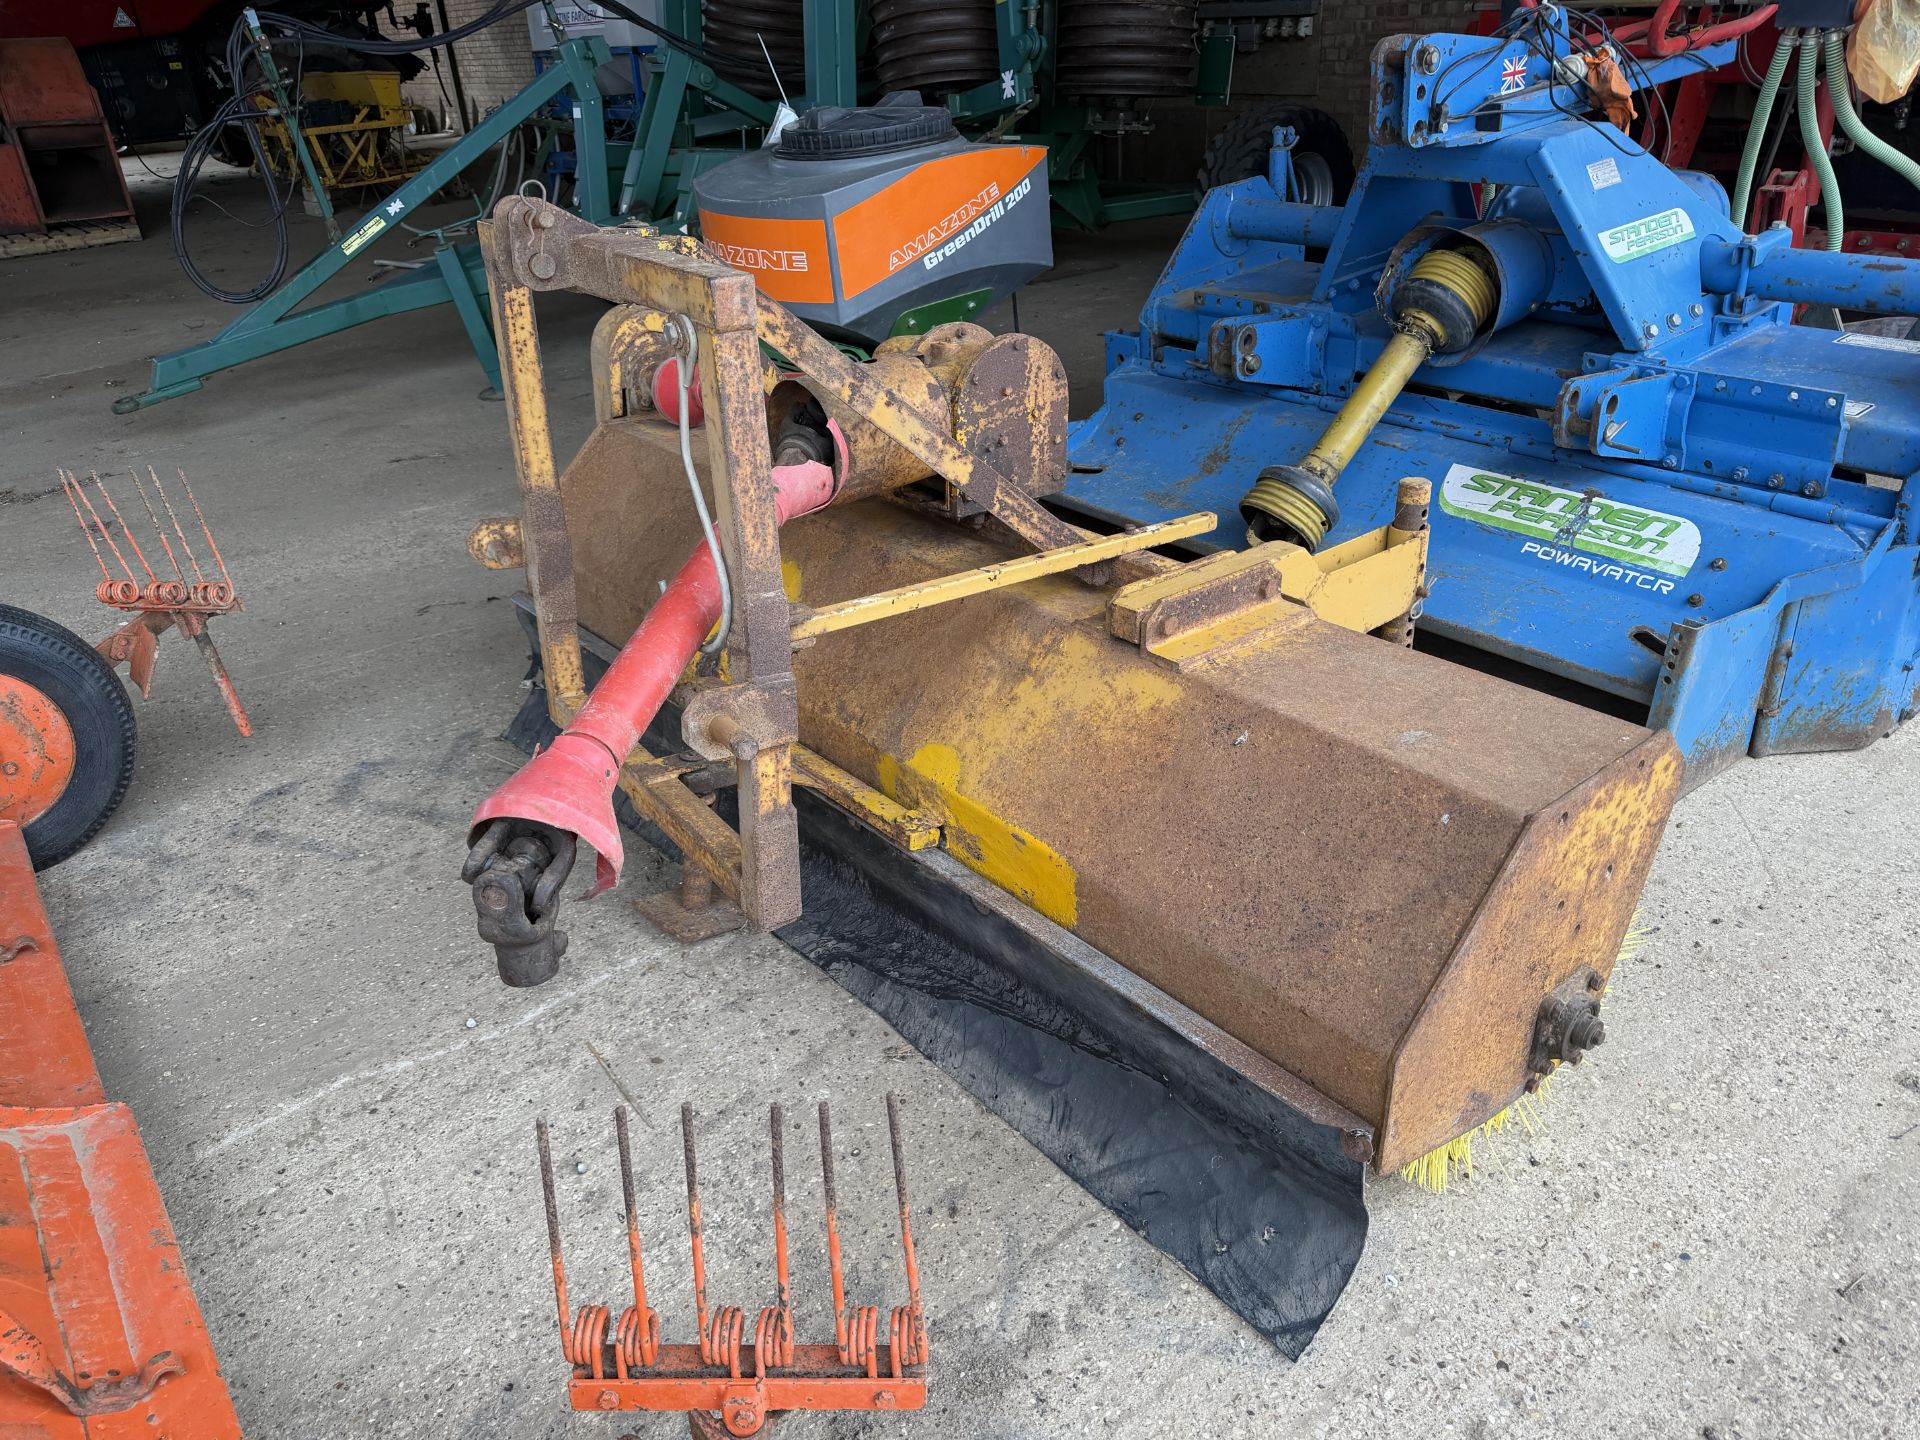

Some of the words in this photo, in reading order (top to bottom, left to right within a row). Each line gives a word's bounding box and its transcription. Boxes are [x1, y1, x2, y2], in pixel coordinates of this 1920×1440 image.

[889, 181, 1000, 271] AMAZONE
[923, 201, 1006, 270] GreenDrill
[1006, 177, 1031, 210] 200
[1608, 210, 1680, 246] STANDEN
[1626, 224, 1684, 251] PEARSON
[703, 239, 808, 272] MAZONE
[1461, 474, 1681, 538] STANDEN
